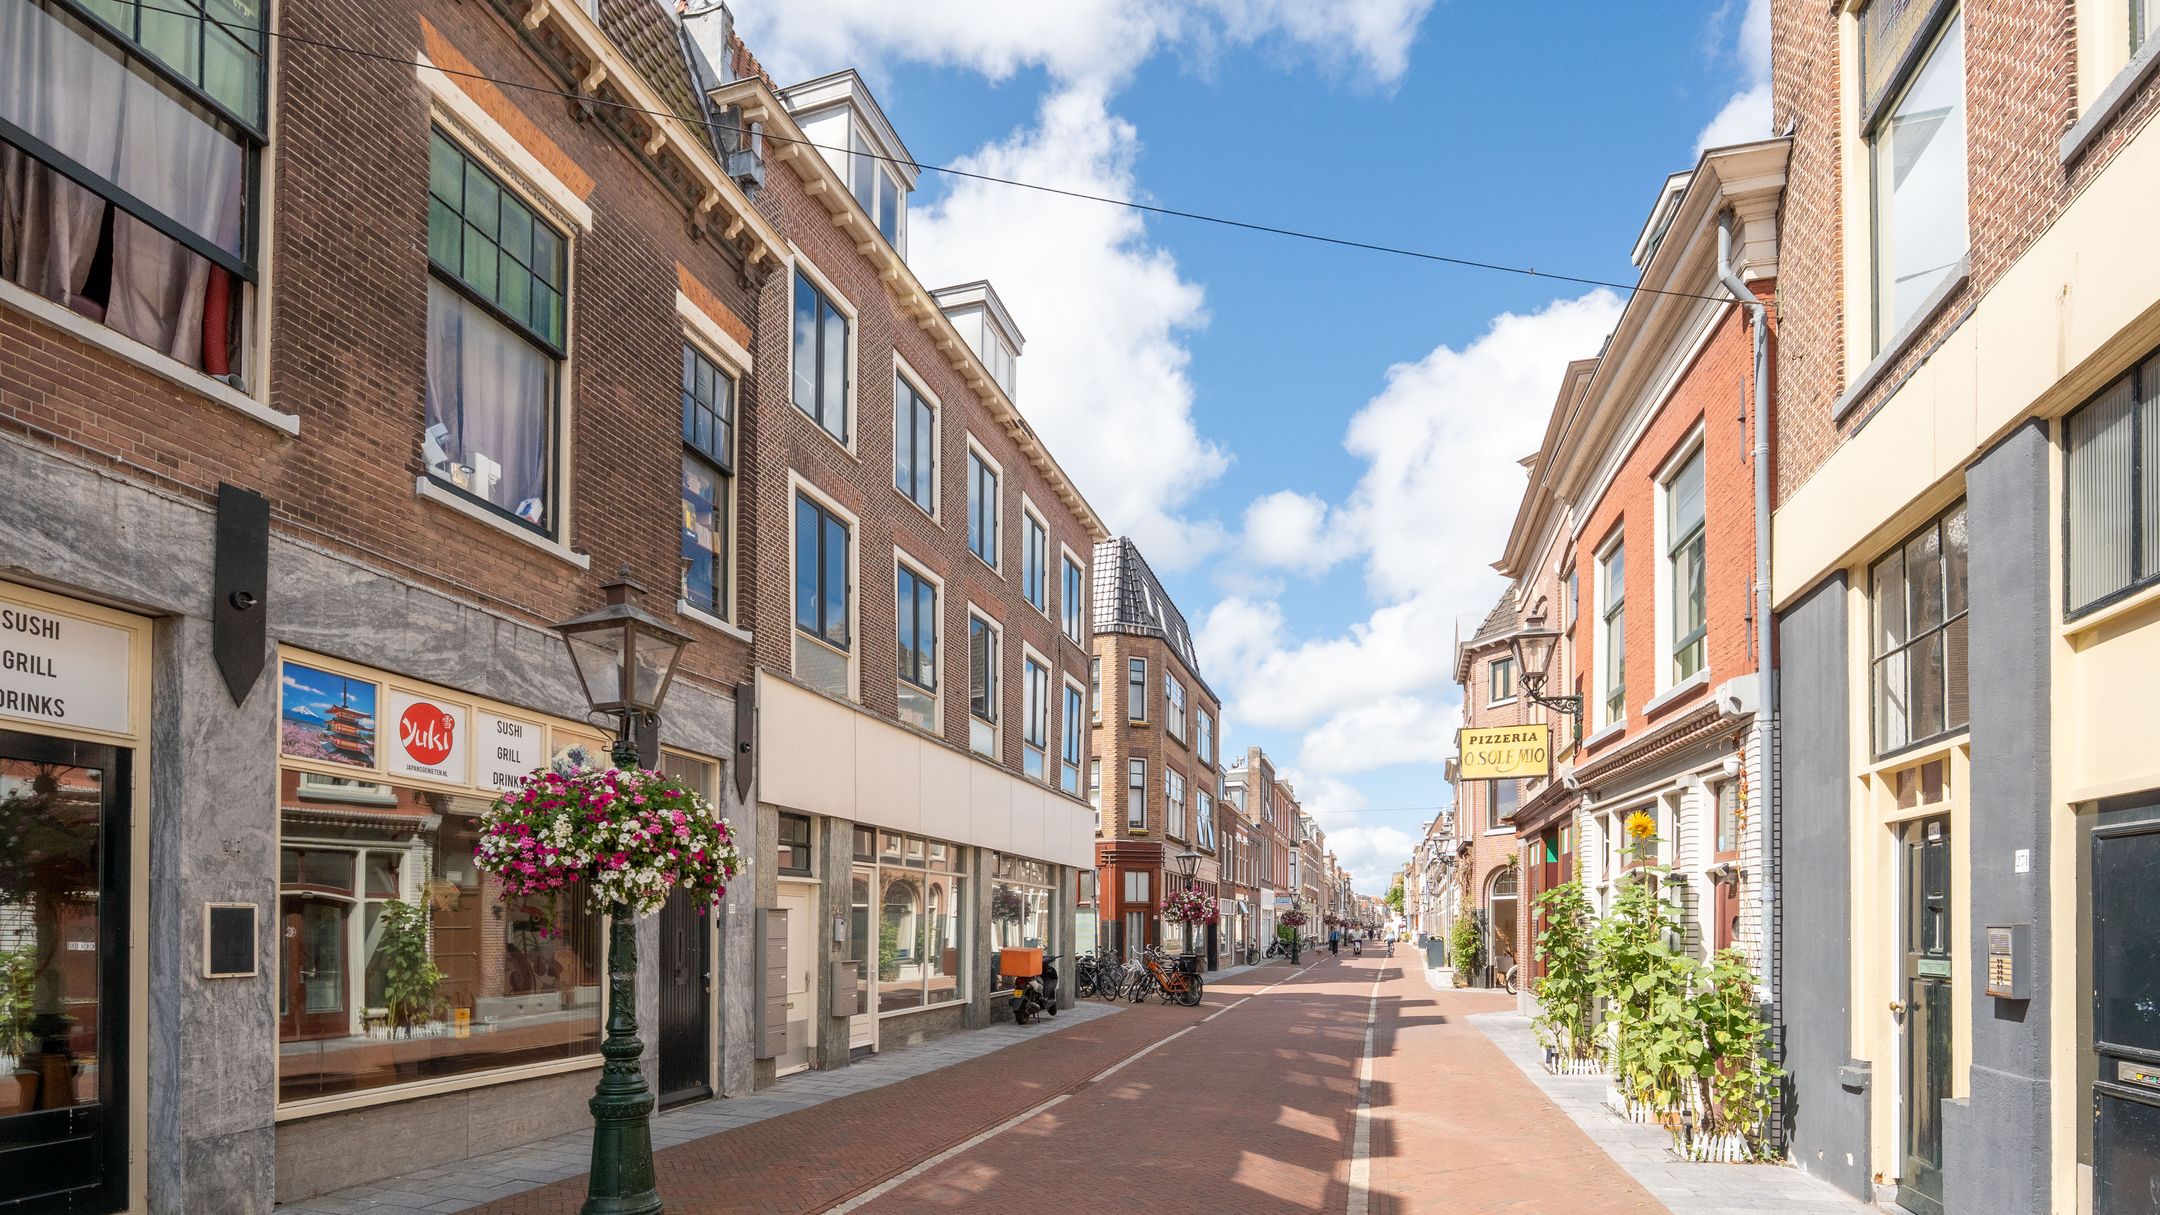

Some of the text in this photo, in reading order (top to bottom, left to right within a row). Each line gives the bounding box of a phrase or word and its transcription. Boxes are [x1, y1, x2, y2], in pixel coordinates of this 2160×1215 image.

[2, 609, 60, 640] SUSHI
[3, 650, 57, 678] GRILL
[497, 720, 523, 738] SUSHI
[1469, 732, 1538, 745] PIZZERIA
[497, 746, 521, 763] GRILL
[1464, 748, 1545, 766] O SOLE MIO
